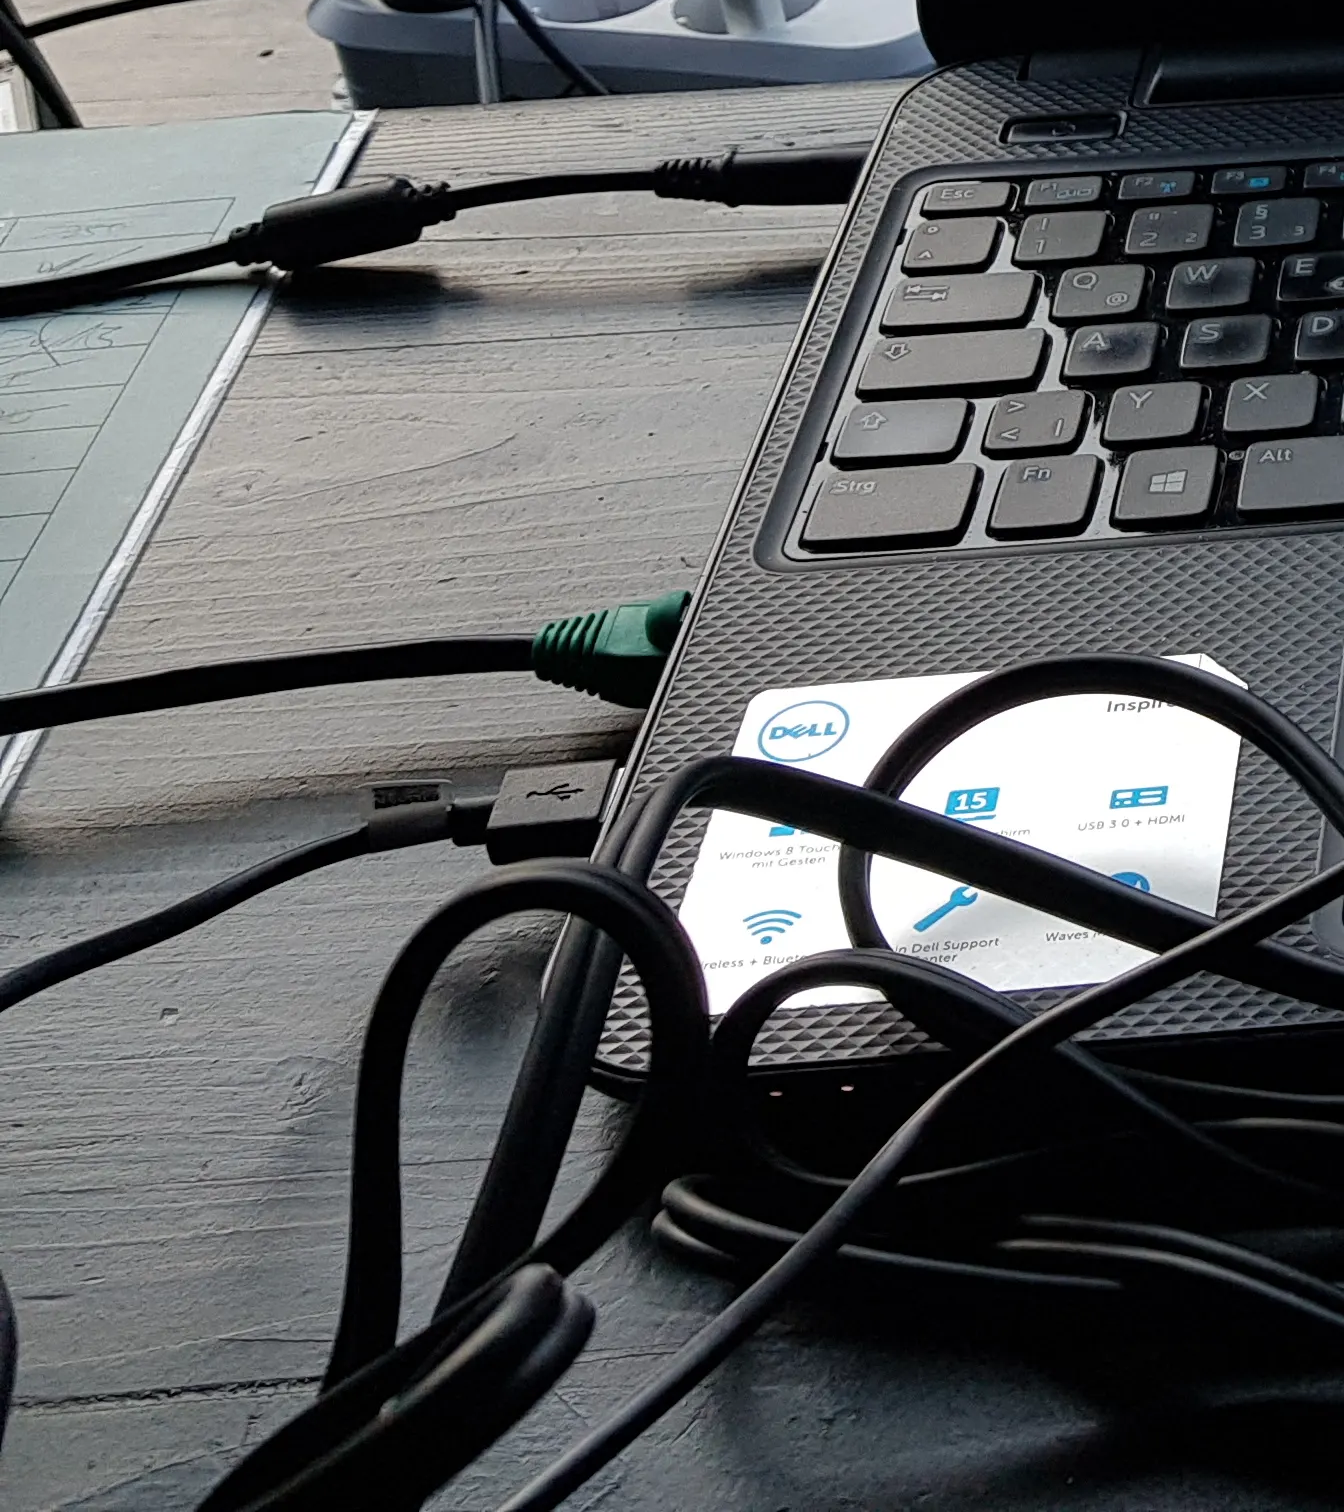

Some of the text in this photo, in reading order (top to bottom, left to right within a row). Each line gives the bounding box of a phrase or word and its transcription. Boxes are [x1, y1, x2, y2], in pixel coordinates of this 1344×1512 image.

[1225, 170, 1245, 181] F3
[1317, 166, 1337, 176] F4
[1135, 175, 1154, 186] F2
[940, 187, 974, 201] Esc
[1139, 232, 1157, 246] 2
[1249, 225, 1266, 240] 3
[1184, 264, 1218, 282] W
[1294, 258, 1315, 275] E
[1072, 271, 1098, 291] Q
[1198, 323, 1224, 342] S
[1311, 316, 1334, 334] D
[1081, 331, 1109, 350] A
[1243, 381, 1271, 401] X
[1129, 391, 1155, 410] Y
[1258, 447, 1294, 464] Alt
[1021, 466, 1052, 482] Fn
[829, 478, 879, 498] Strg
[769, 721, 838, 741] DELL
[953, 791, 988, 811] 15
[1077, 820, 1105, 832] USB
[1146, 814, 1186, 827] HDMI
[719, 848, 782, 861] Windows
[785, 845, 795, 857] 8
[751, 855, 827, 869] mit Gesten
[1045, 930, 1089, 942] Waves
[911, 938, 1000, 954] Dell Support
